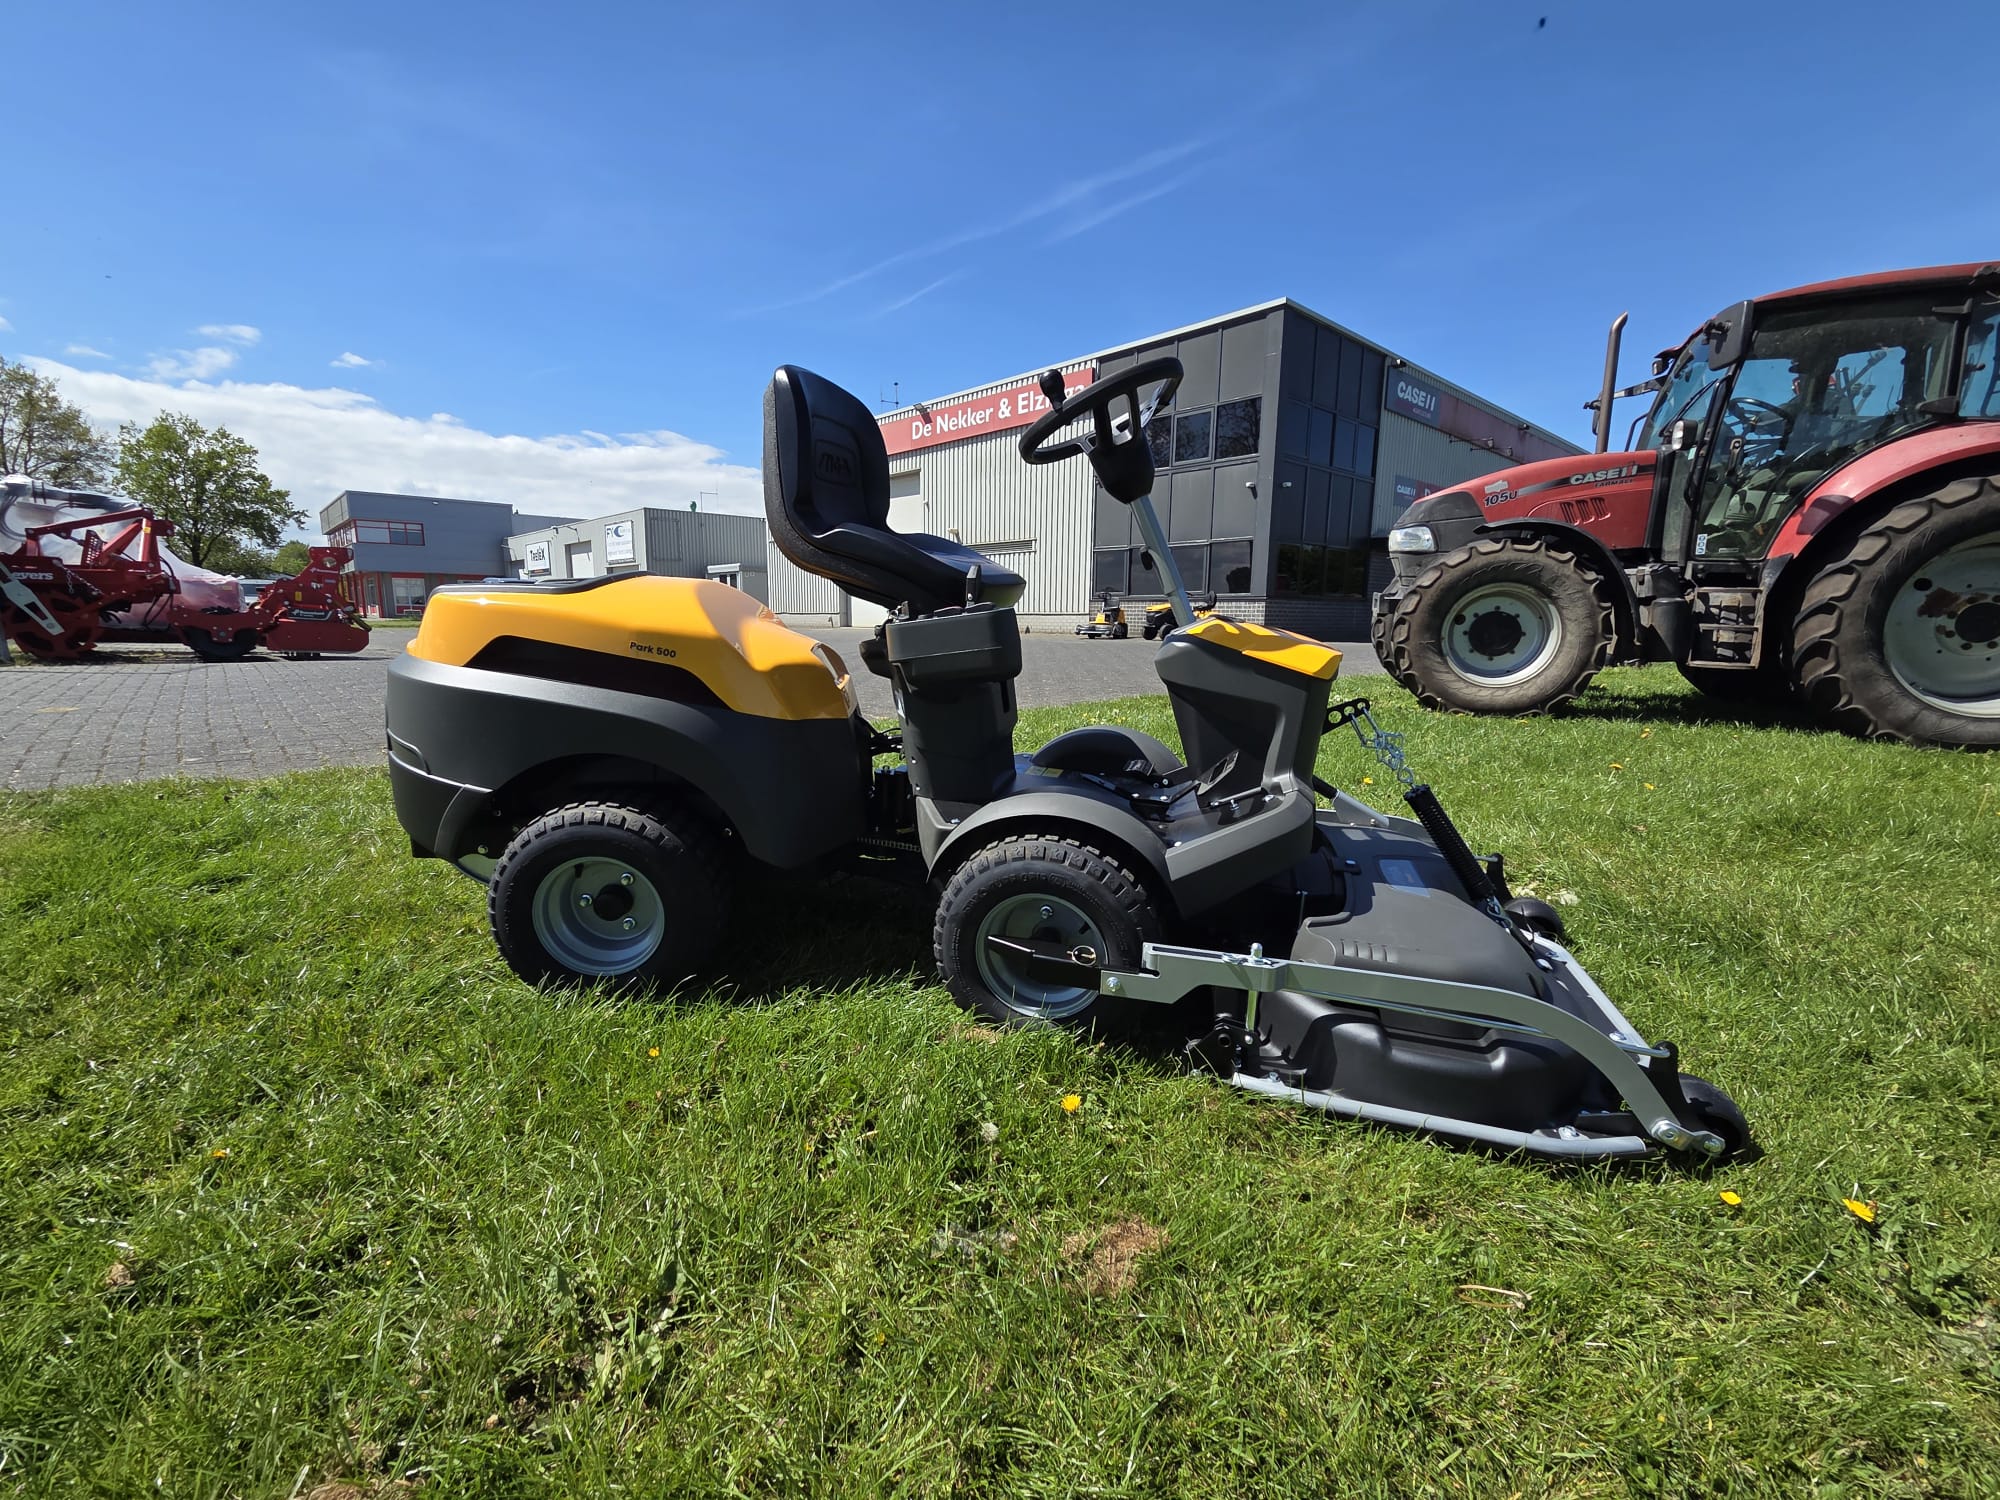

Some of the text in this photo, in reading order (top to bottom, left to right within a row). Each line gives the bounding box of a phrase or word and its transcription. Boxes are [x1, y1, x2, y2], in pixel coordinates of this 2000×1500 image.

[912, 420, 932, 440] De
[936, 407, 994, 435] Nekker
[998, 398, 1012, 419] &
[1570, 468, 1620, 485] CASE
[1485, 490, 1518, 506] 105U
[630, 641, 677, 658] Park 500
